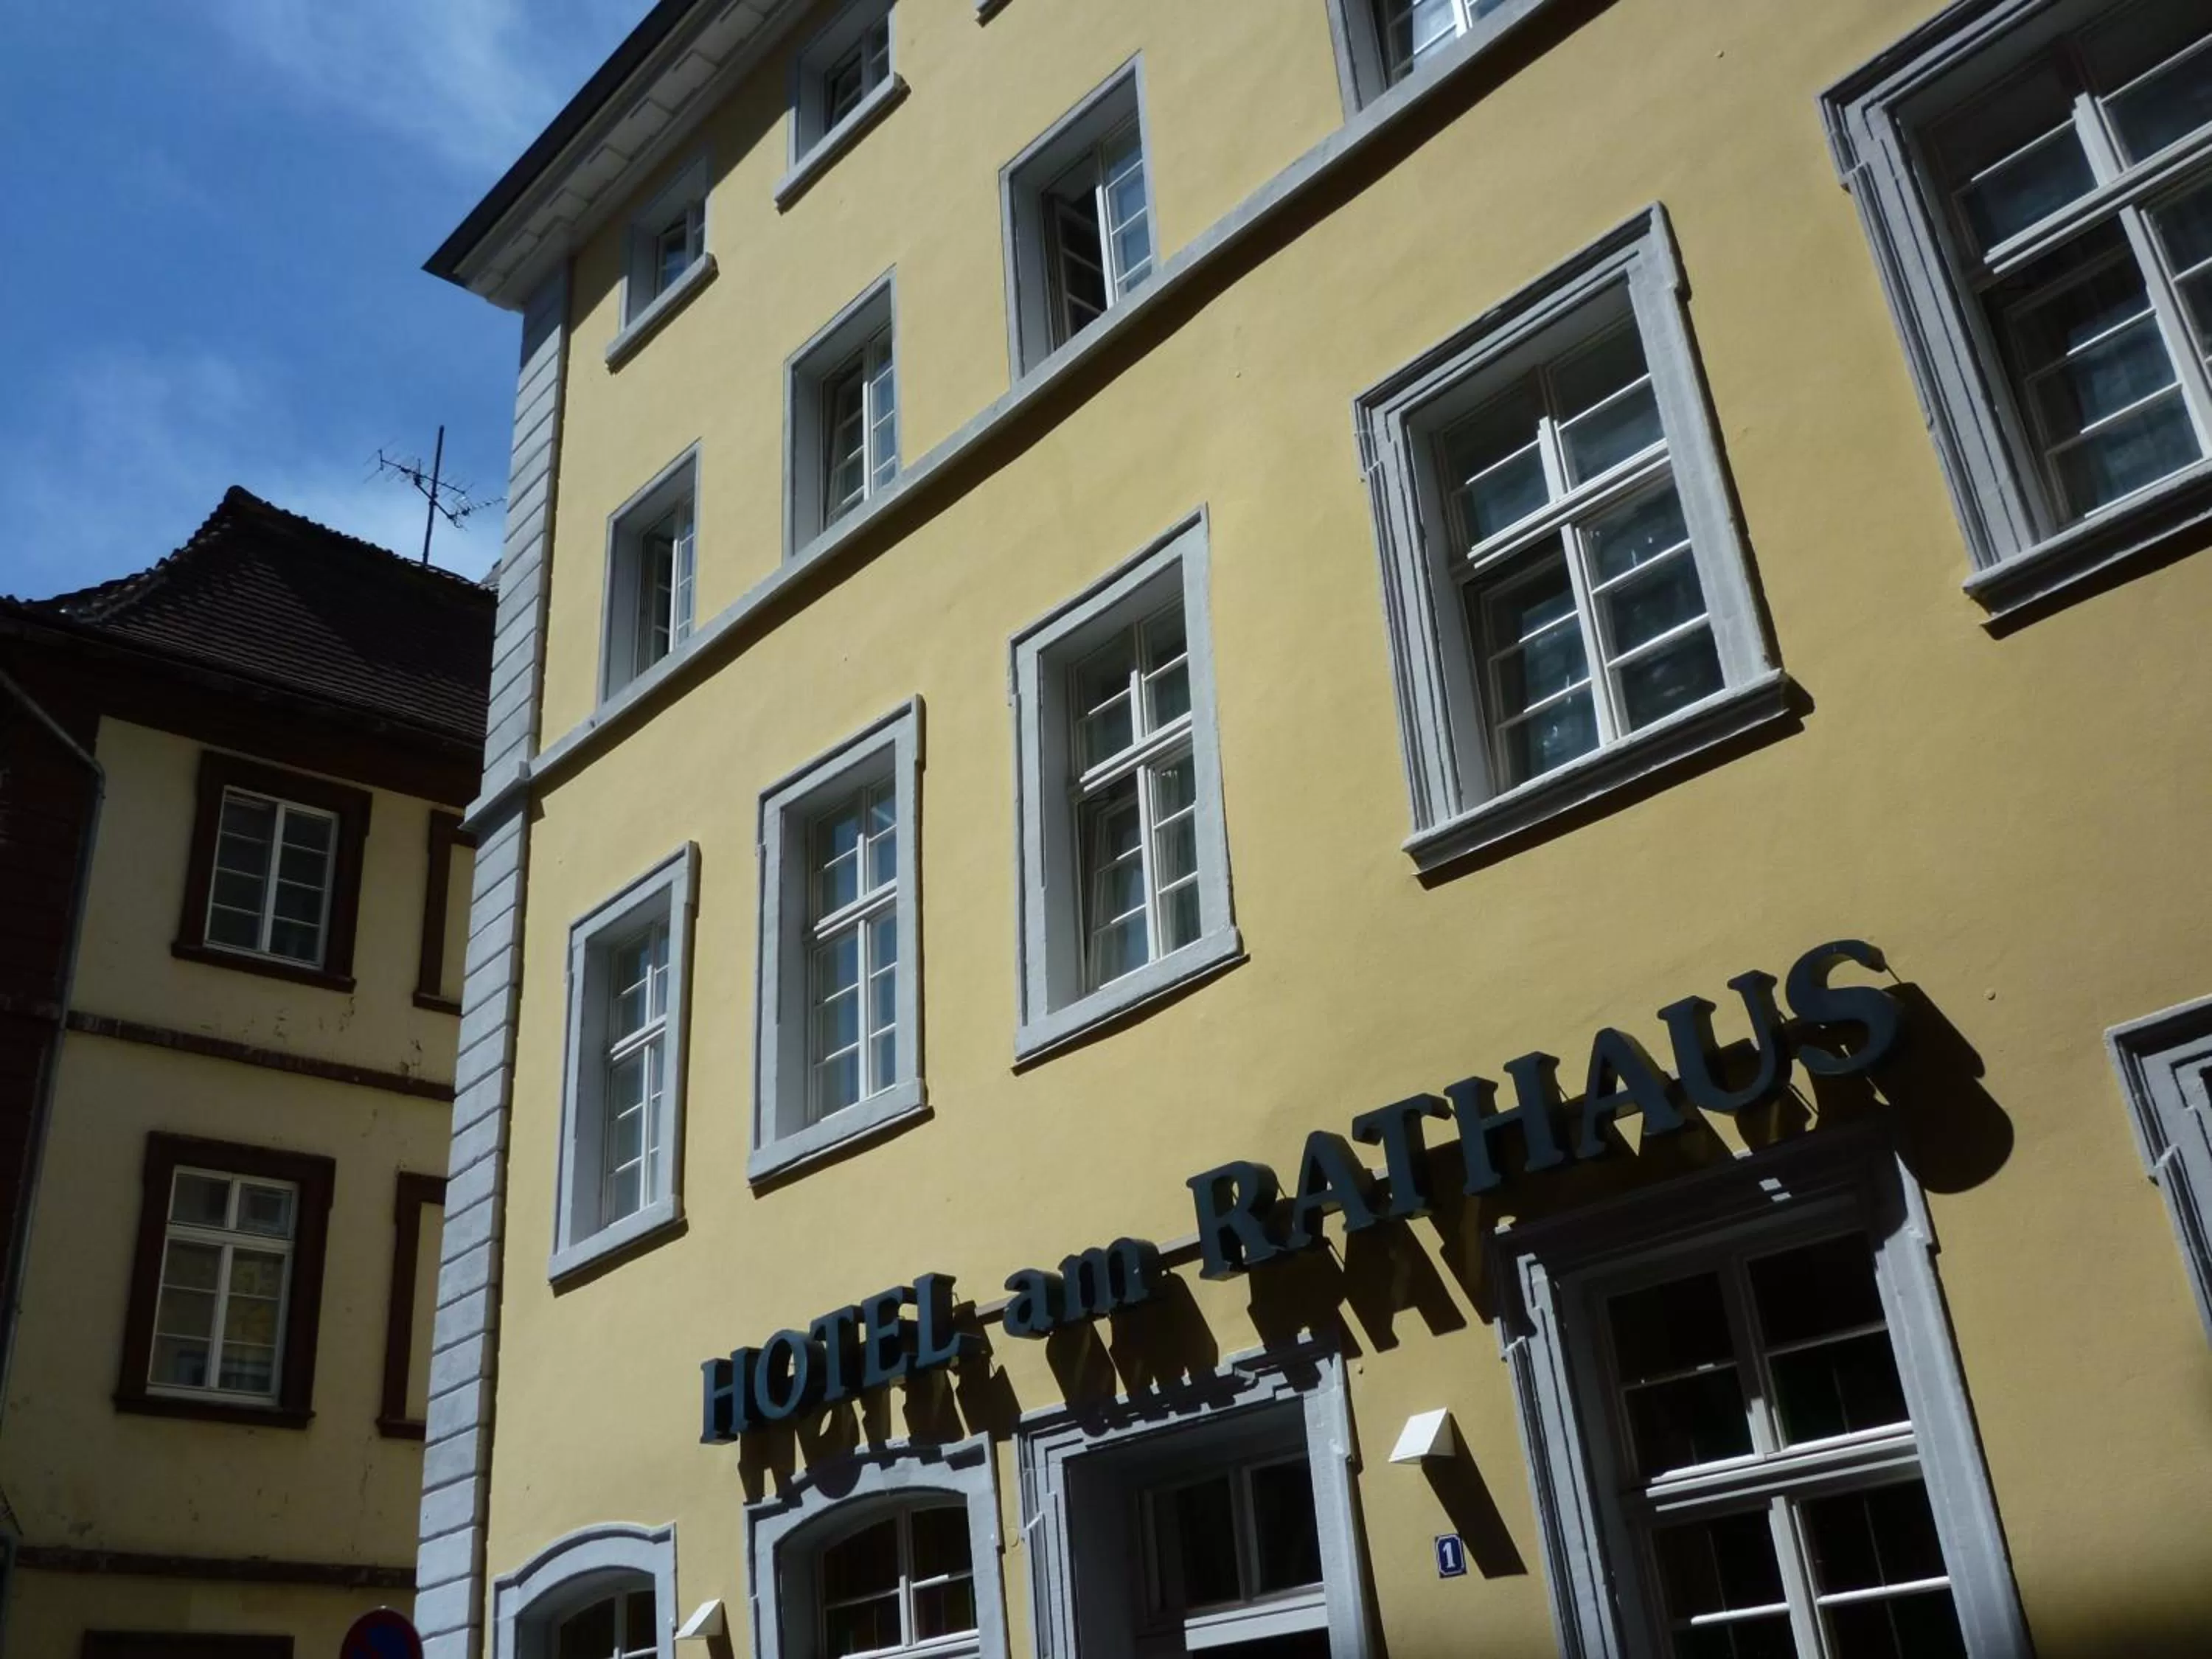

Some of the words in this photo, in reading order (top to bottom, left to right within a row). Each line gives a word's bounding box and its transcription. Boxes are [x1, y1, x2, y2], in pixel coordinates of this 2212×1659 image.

[700, 1272, 961, 1444] HOTEL
[1002, 1236, 1159, 1340] am
[1186, 939, 1900, 1281] RATHAUS
[1443, 1542, 1456, 1569] 1
